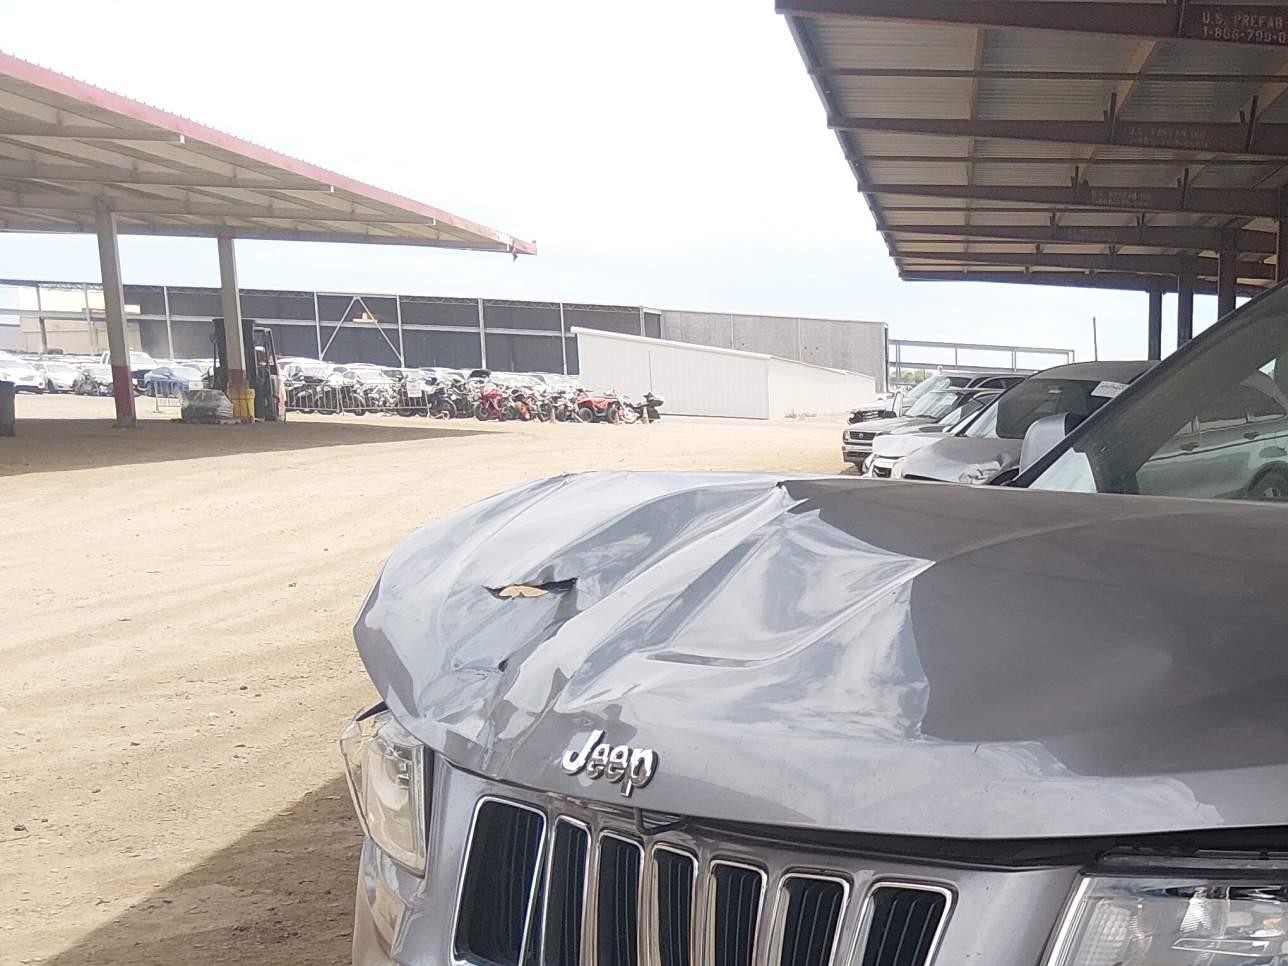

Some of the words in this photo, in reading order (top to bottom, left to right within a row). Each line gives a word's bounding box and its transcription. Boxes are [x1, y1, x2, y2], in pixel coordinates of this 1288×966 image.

[1202, 11, 1226, 25] U.S.
[1233, 14, 1283, 29] PREFAB
[560, 729, 659, 798] Jeep
